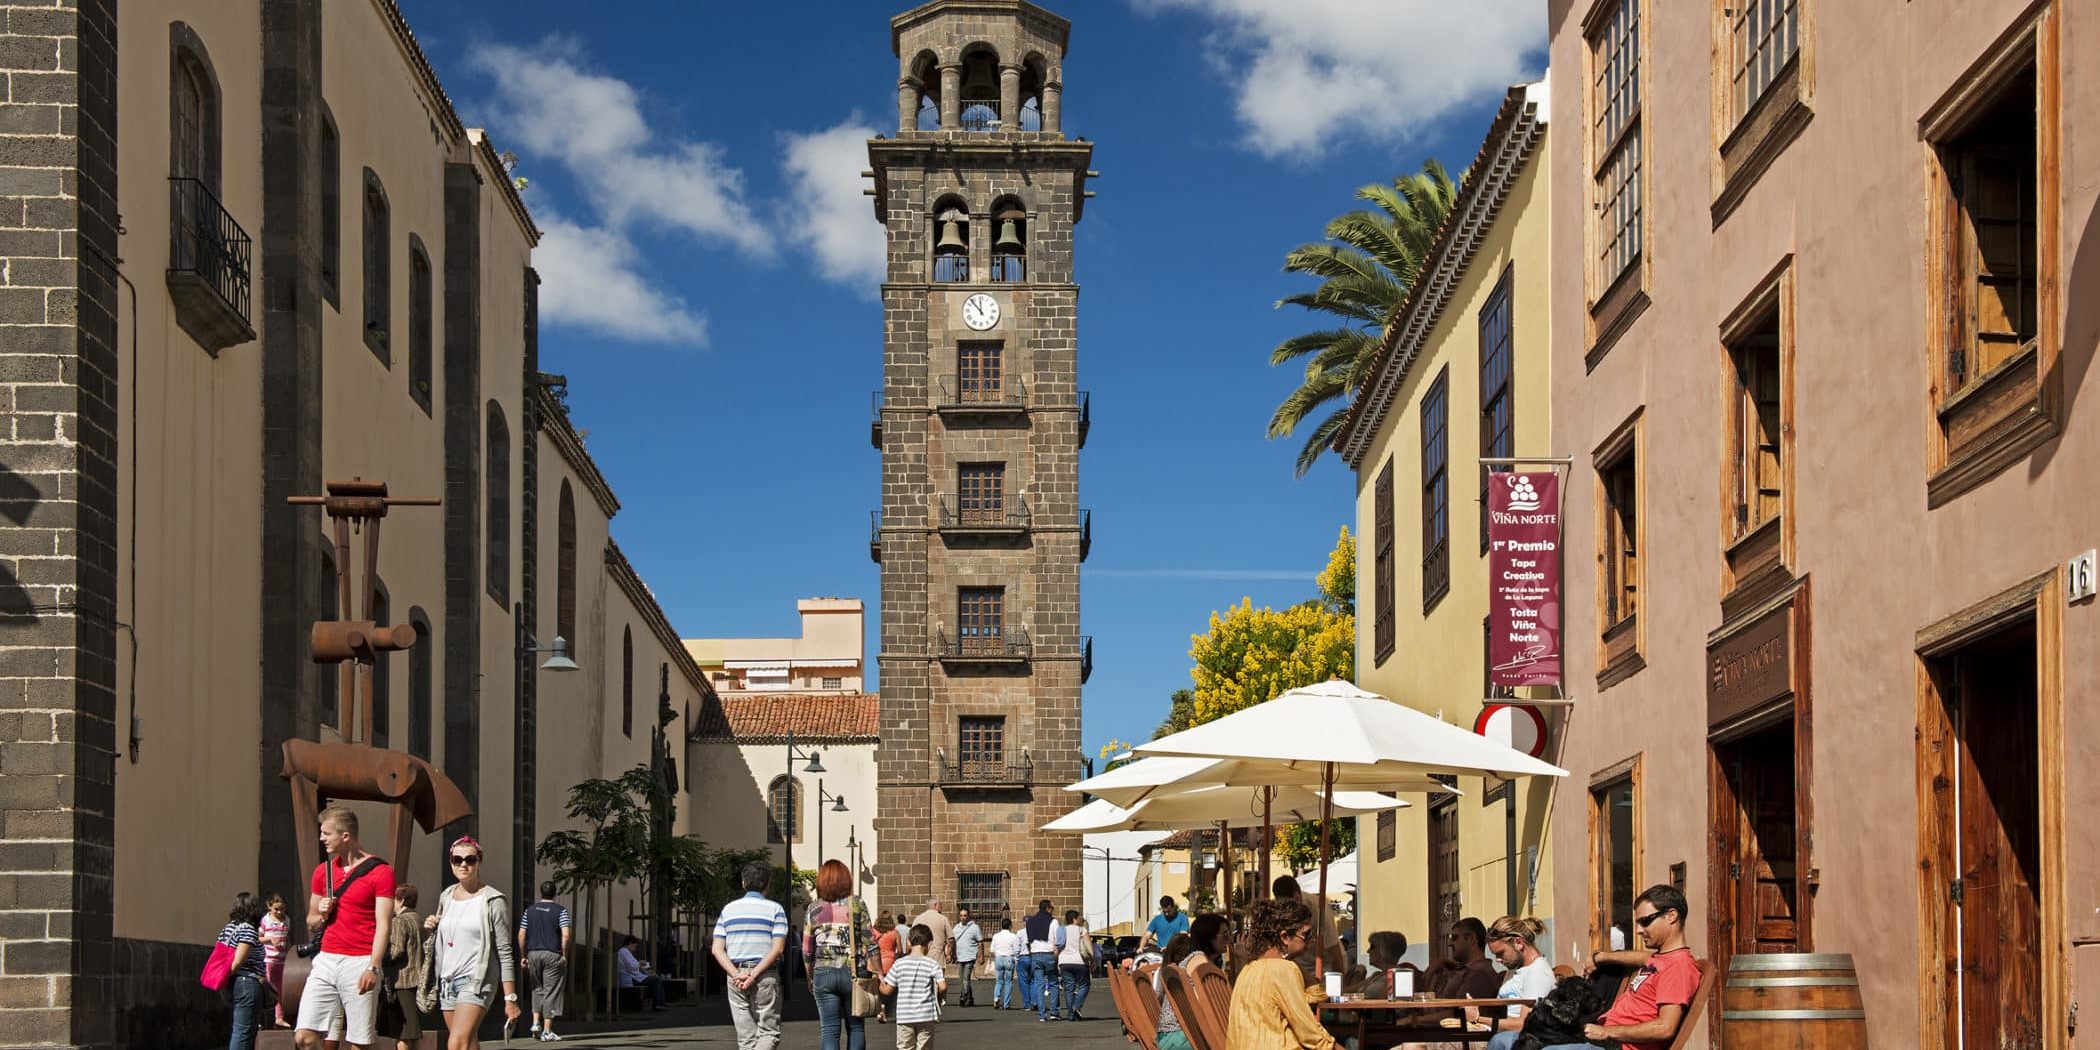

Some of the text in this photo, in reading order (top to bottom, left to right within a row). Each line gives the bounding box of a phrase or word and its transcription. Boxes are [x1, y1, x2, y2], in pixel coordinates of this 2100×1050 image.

[1493, 513, 1557, 524] VIÑA NORTE
[1493, 539, 1555, 551] 1er Premio
[1511, 558, 1536, 568] Tapa
[1503, 571, 1544, 580] Creativa
[2069, 559, 2088, 595] 16
[1510, 607, 1537, 617] Tosta
[1512, 620, 1536, 629] Viña
[1510, 632, 1539, 642] Norte
